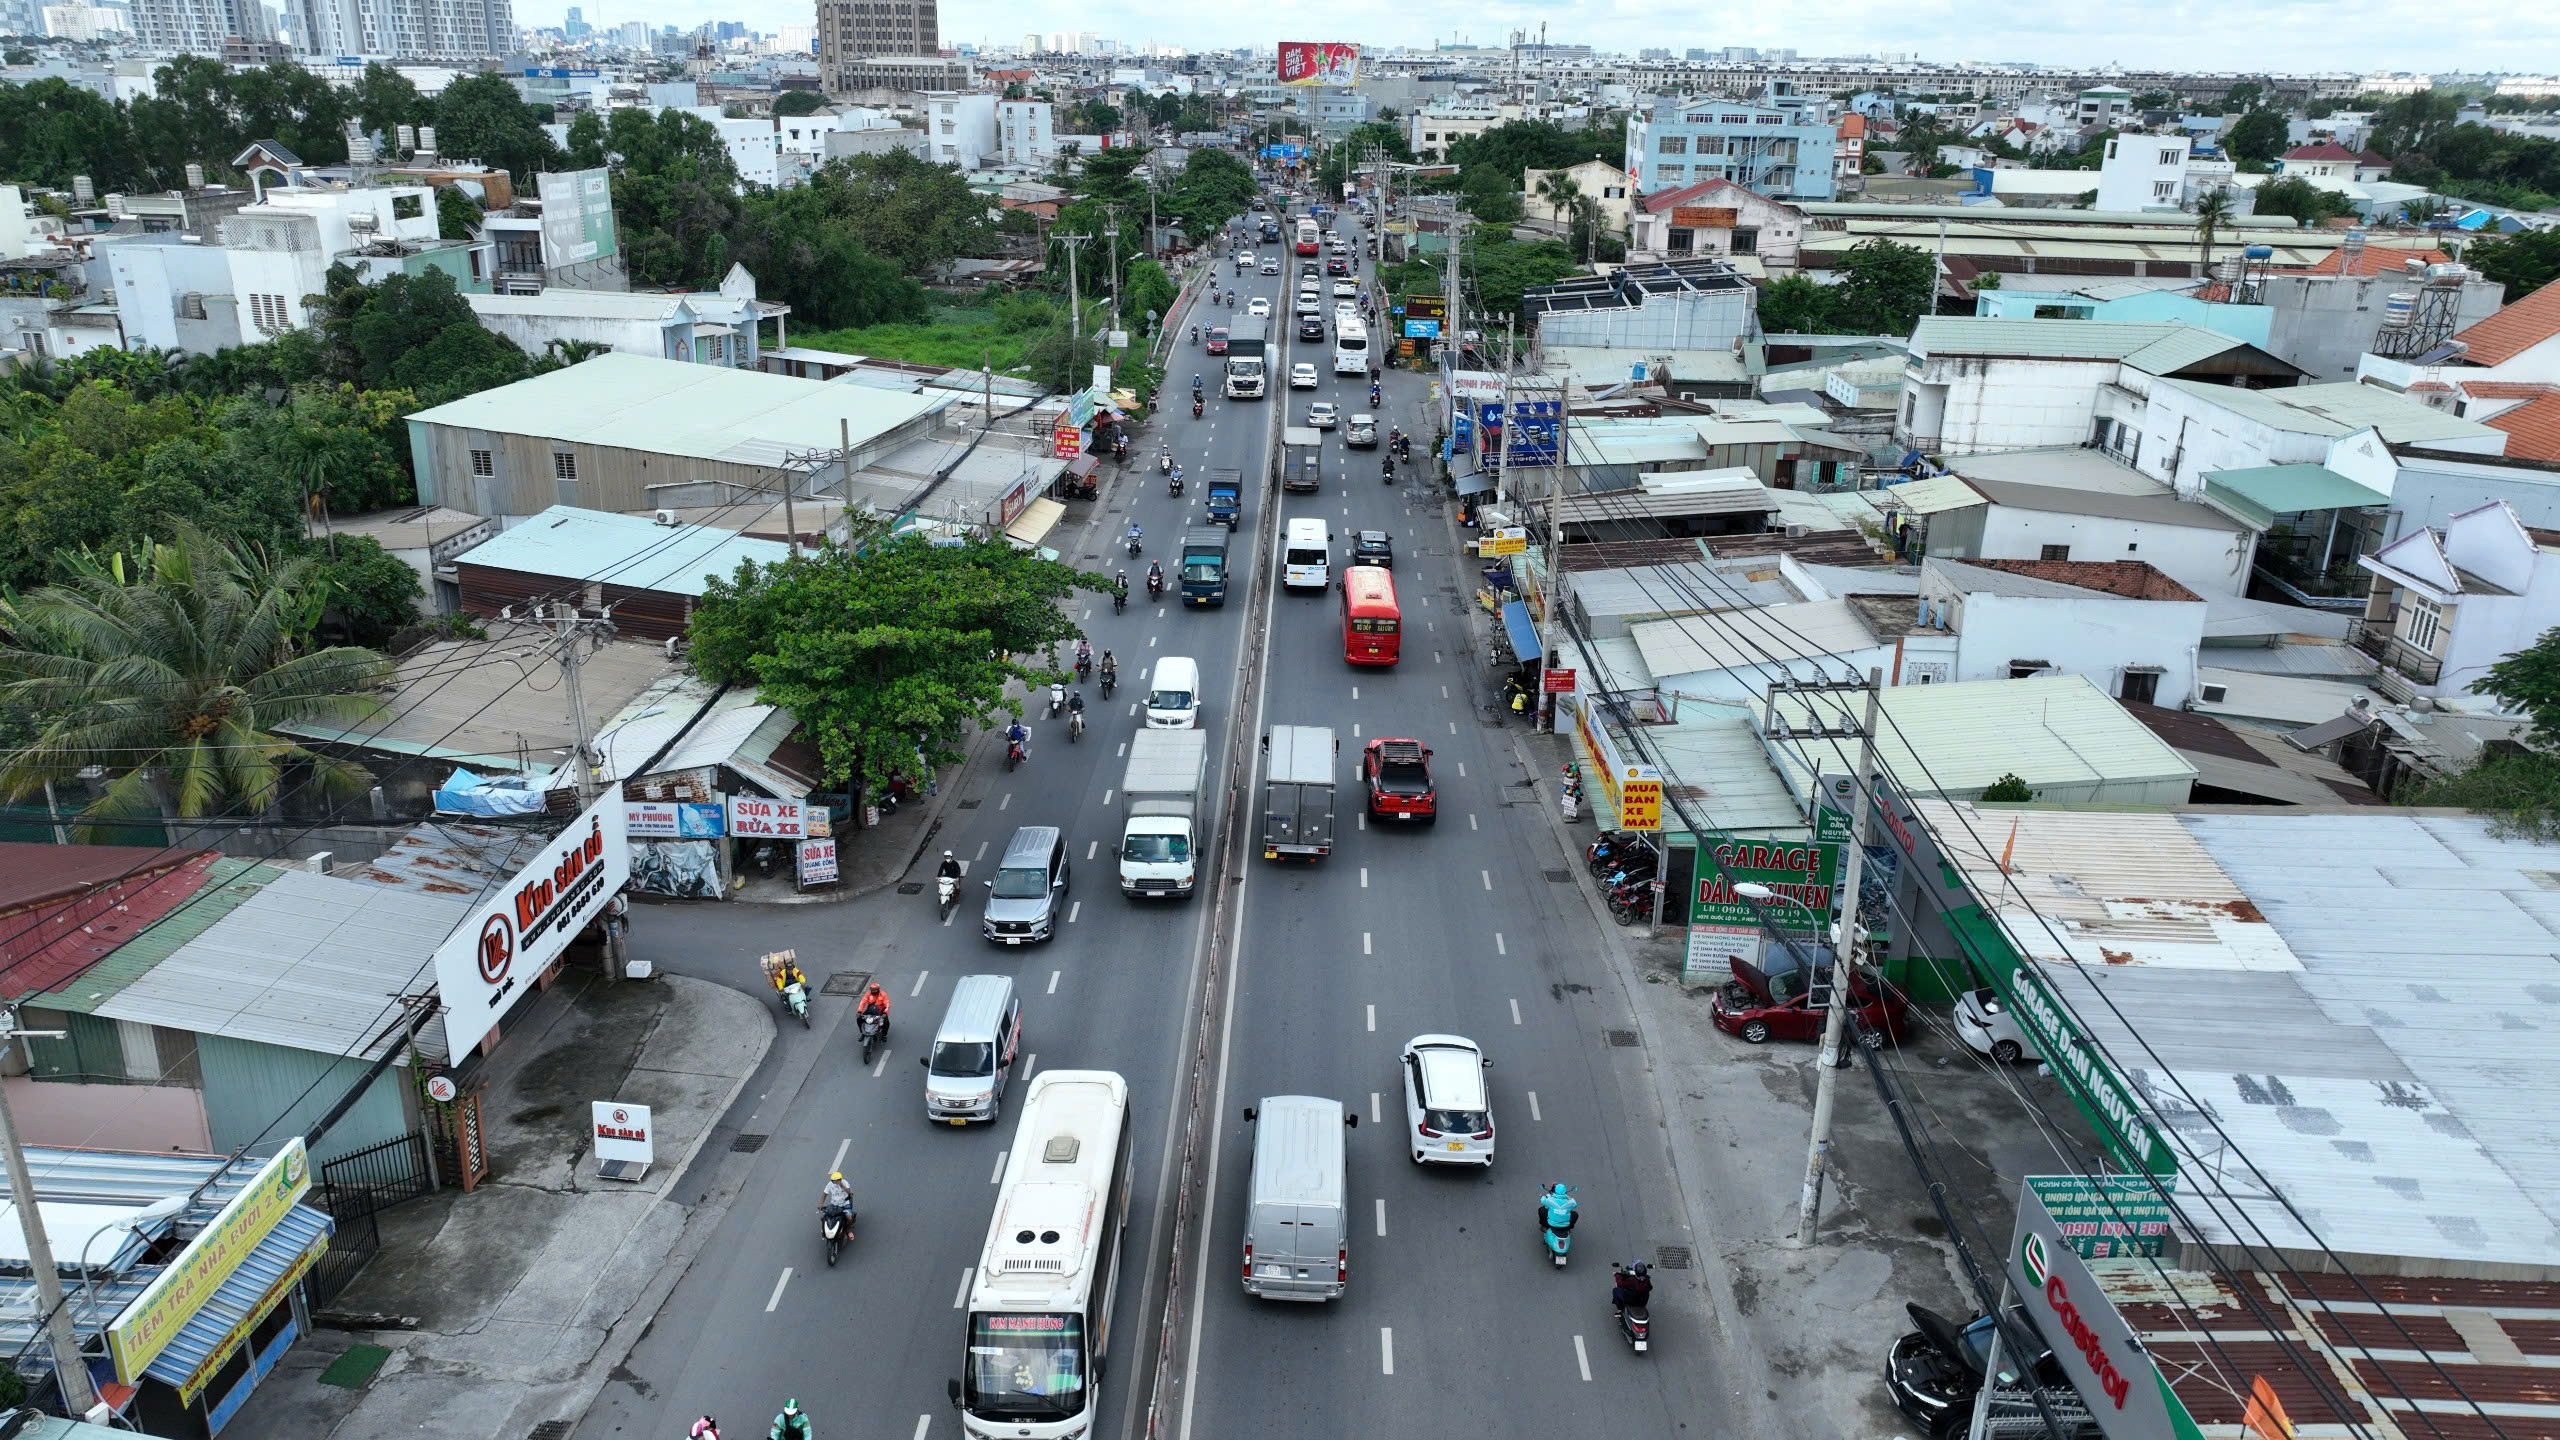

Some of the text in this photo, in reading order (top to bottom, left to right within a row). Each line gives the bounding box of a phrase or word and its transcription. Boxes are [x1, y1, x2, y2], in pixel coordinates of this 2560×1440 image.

[1625, 784, 1659, 793] MUA
[1624, 795, 1655, 804] BÁN
[737, 800, 771, 816] SỬA
[777, 805, 798, 818] XE
[736, 817, 800, 835] RỬA XE
[1624, 816, 1657, 827] MÁY
[1882, 799, 1917, 855] Castrol
[554, 850, 584, 893] SÀN
[584, 815, 602, 865] GỖ
[824, 845, 834, 858] XE
[1715, 844, 1821, 871] GARAGE
[1698, 874, 1740, 905] DÂN
[1722, 905, 1750, 915] 0903
[2012, 968, 2061, 1040] GARAGE
[618, 1128, 633, 1137] SÀN
[2037, 1180, 2059, 1188] MUCH
[128, 1312, 164, 1352] TIỆM
[167, 1277, 195, 1310] TRÀ
[199, 1241, 227, 1280] NHÀ
[264, 1194, 273, 1210] 2
[989, 1315, 1064, 1331] KIM MẠNH HÙNG
[2047, 1275, 2129, 1410] Castrol
